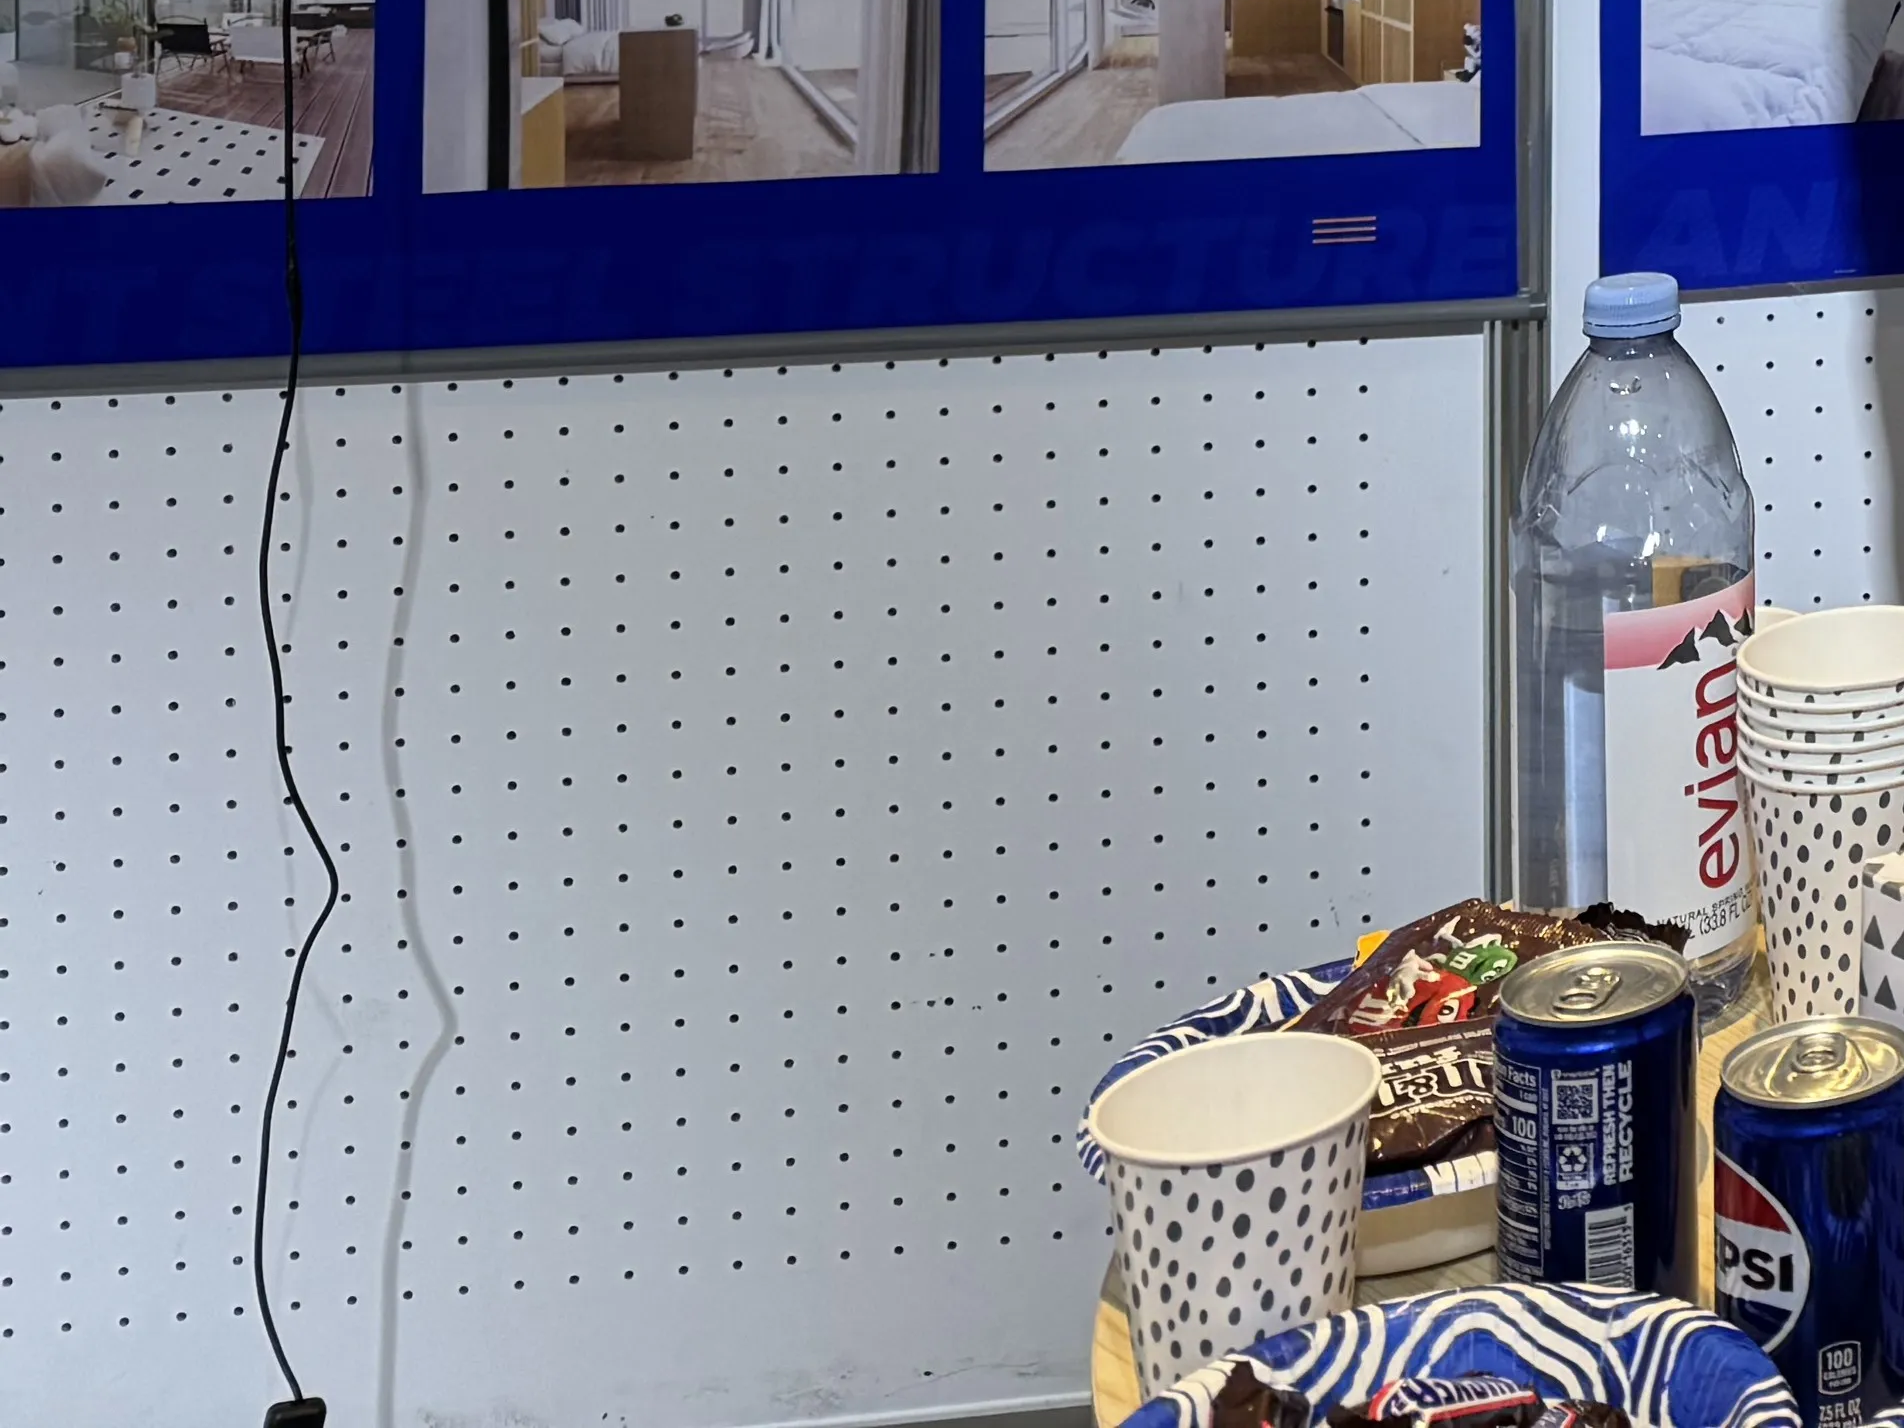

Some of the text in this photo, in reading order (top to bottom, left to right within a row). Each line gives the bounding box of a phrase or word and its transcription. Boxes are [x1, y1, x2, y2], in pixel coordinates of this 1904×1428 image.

[1507, 1065, 1537, 1089] Facts
[1511, 1115, 1537, 1139] 100
[1602, 1064, 1617, 1186] REFRESH THEN
[1618, 1059, 1634, 1183] RECYCLE
[1825, 1347, 1852, 1370] 100
[1848, 1397, 1861, 1416] OZ
